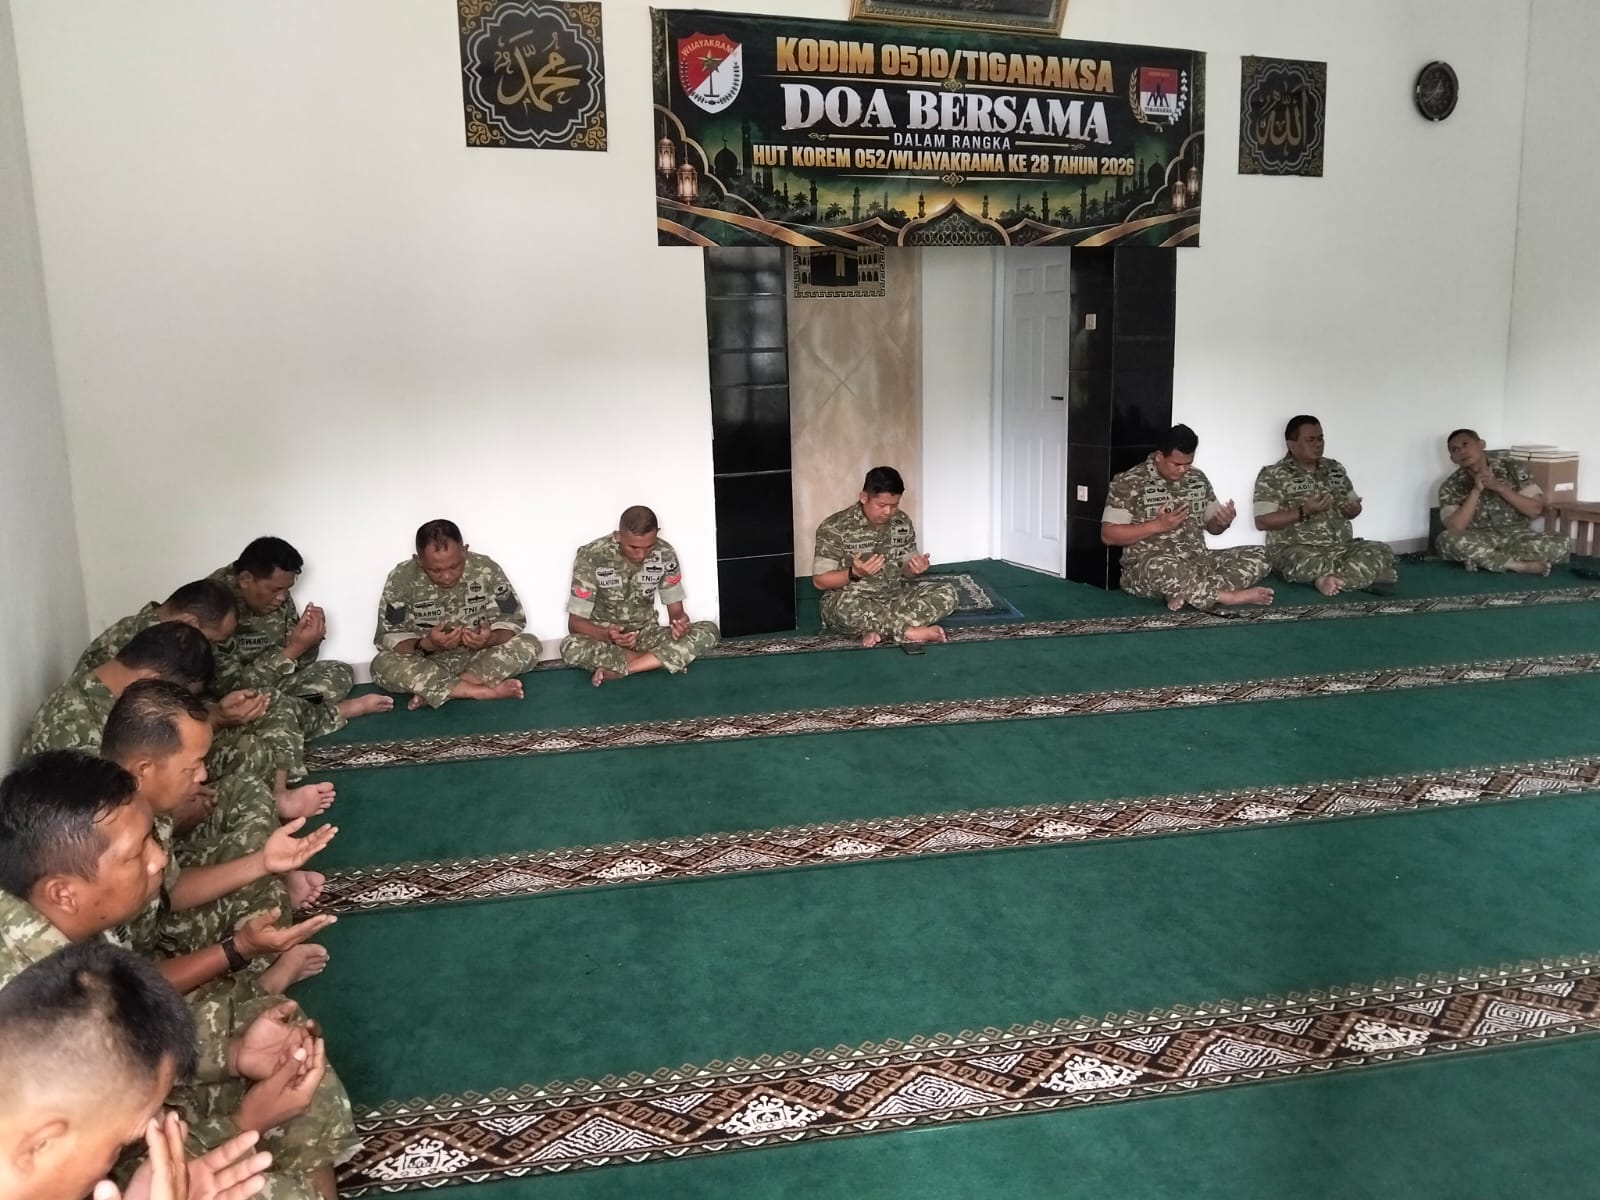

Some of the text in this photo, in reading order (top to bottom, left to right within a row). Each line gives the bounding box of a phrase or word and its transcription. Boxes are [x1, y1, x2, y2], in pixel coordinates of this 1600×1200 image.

[680, 39, 735, 56] WIJAYAKRAM
[776, 36, 1114, 93] KODIM 0510/TIGARAKSA
[780, 83, 1112, 145] DOA BERSAMA
[893, 132, 1011, 150] DALAM RANGKA
[753, 144, 1135, 176] HUT KOREM 052/WIJAYAKRAMA KE 28 TAHUN 2026
